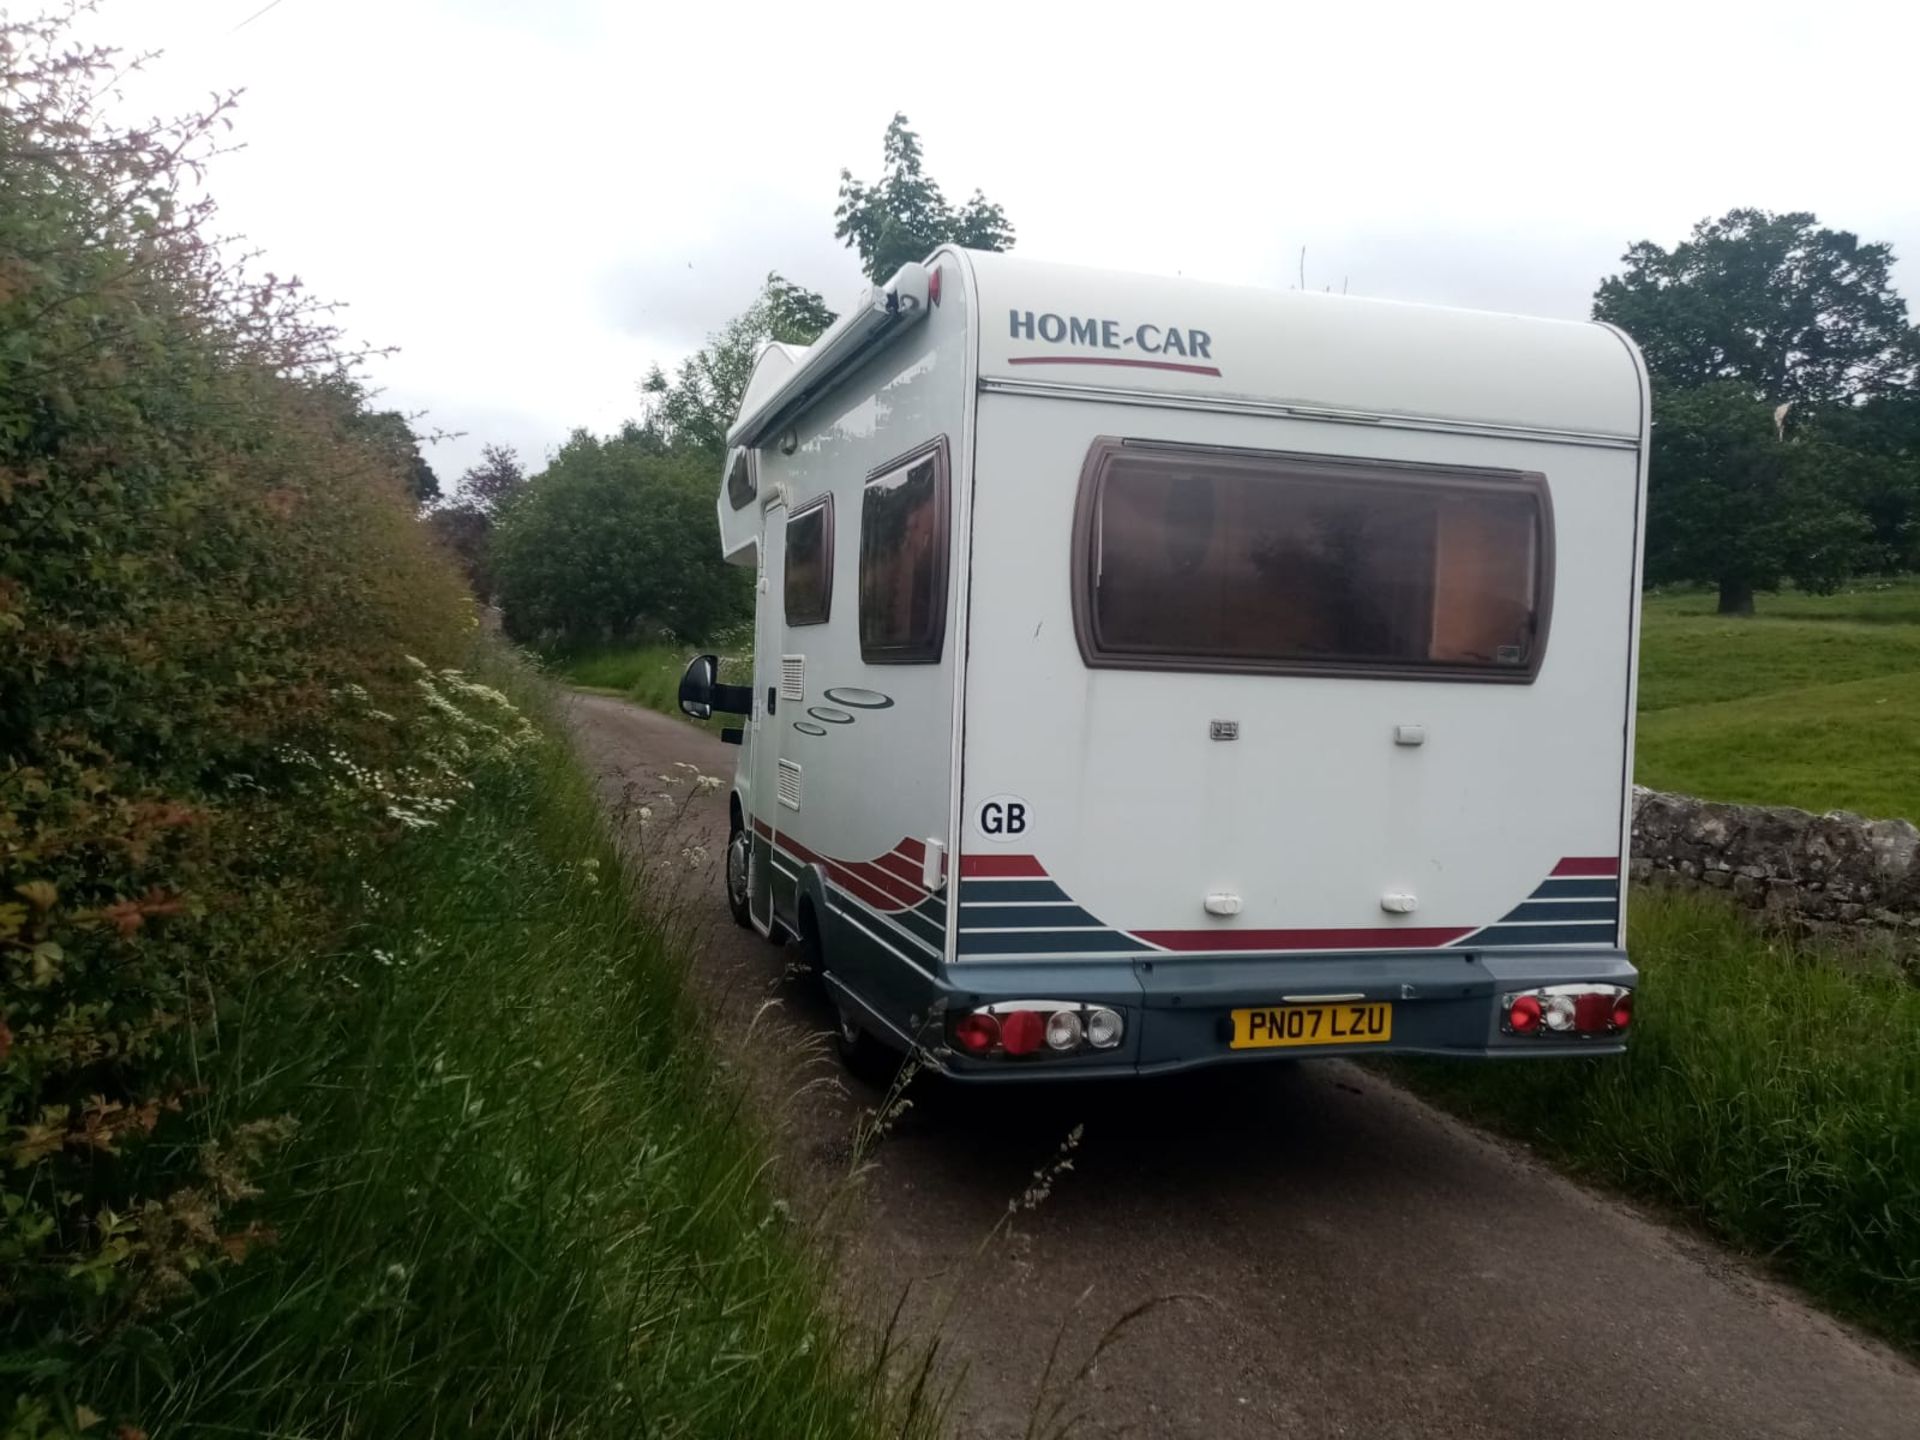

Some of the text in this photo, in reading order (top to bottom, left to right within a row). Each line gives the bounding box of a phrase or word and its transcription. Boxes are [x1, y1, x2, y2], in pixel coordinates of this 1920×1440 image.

[1009, 309, 1212, 359] HOME-CAR
[981, 802, 1026, 834] GB
[1249, 1007, 1384, 1040] PN07 LZU
